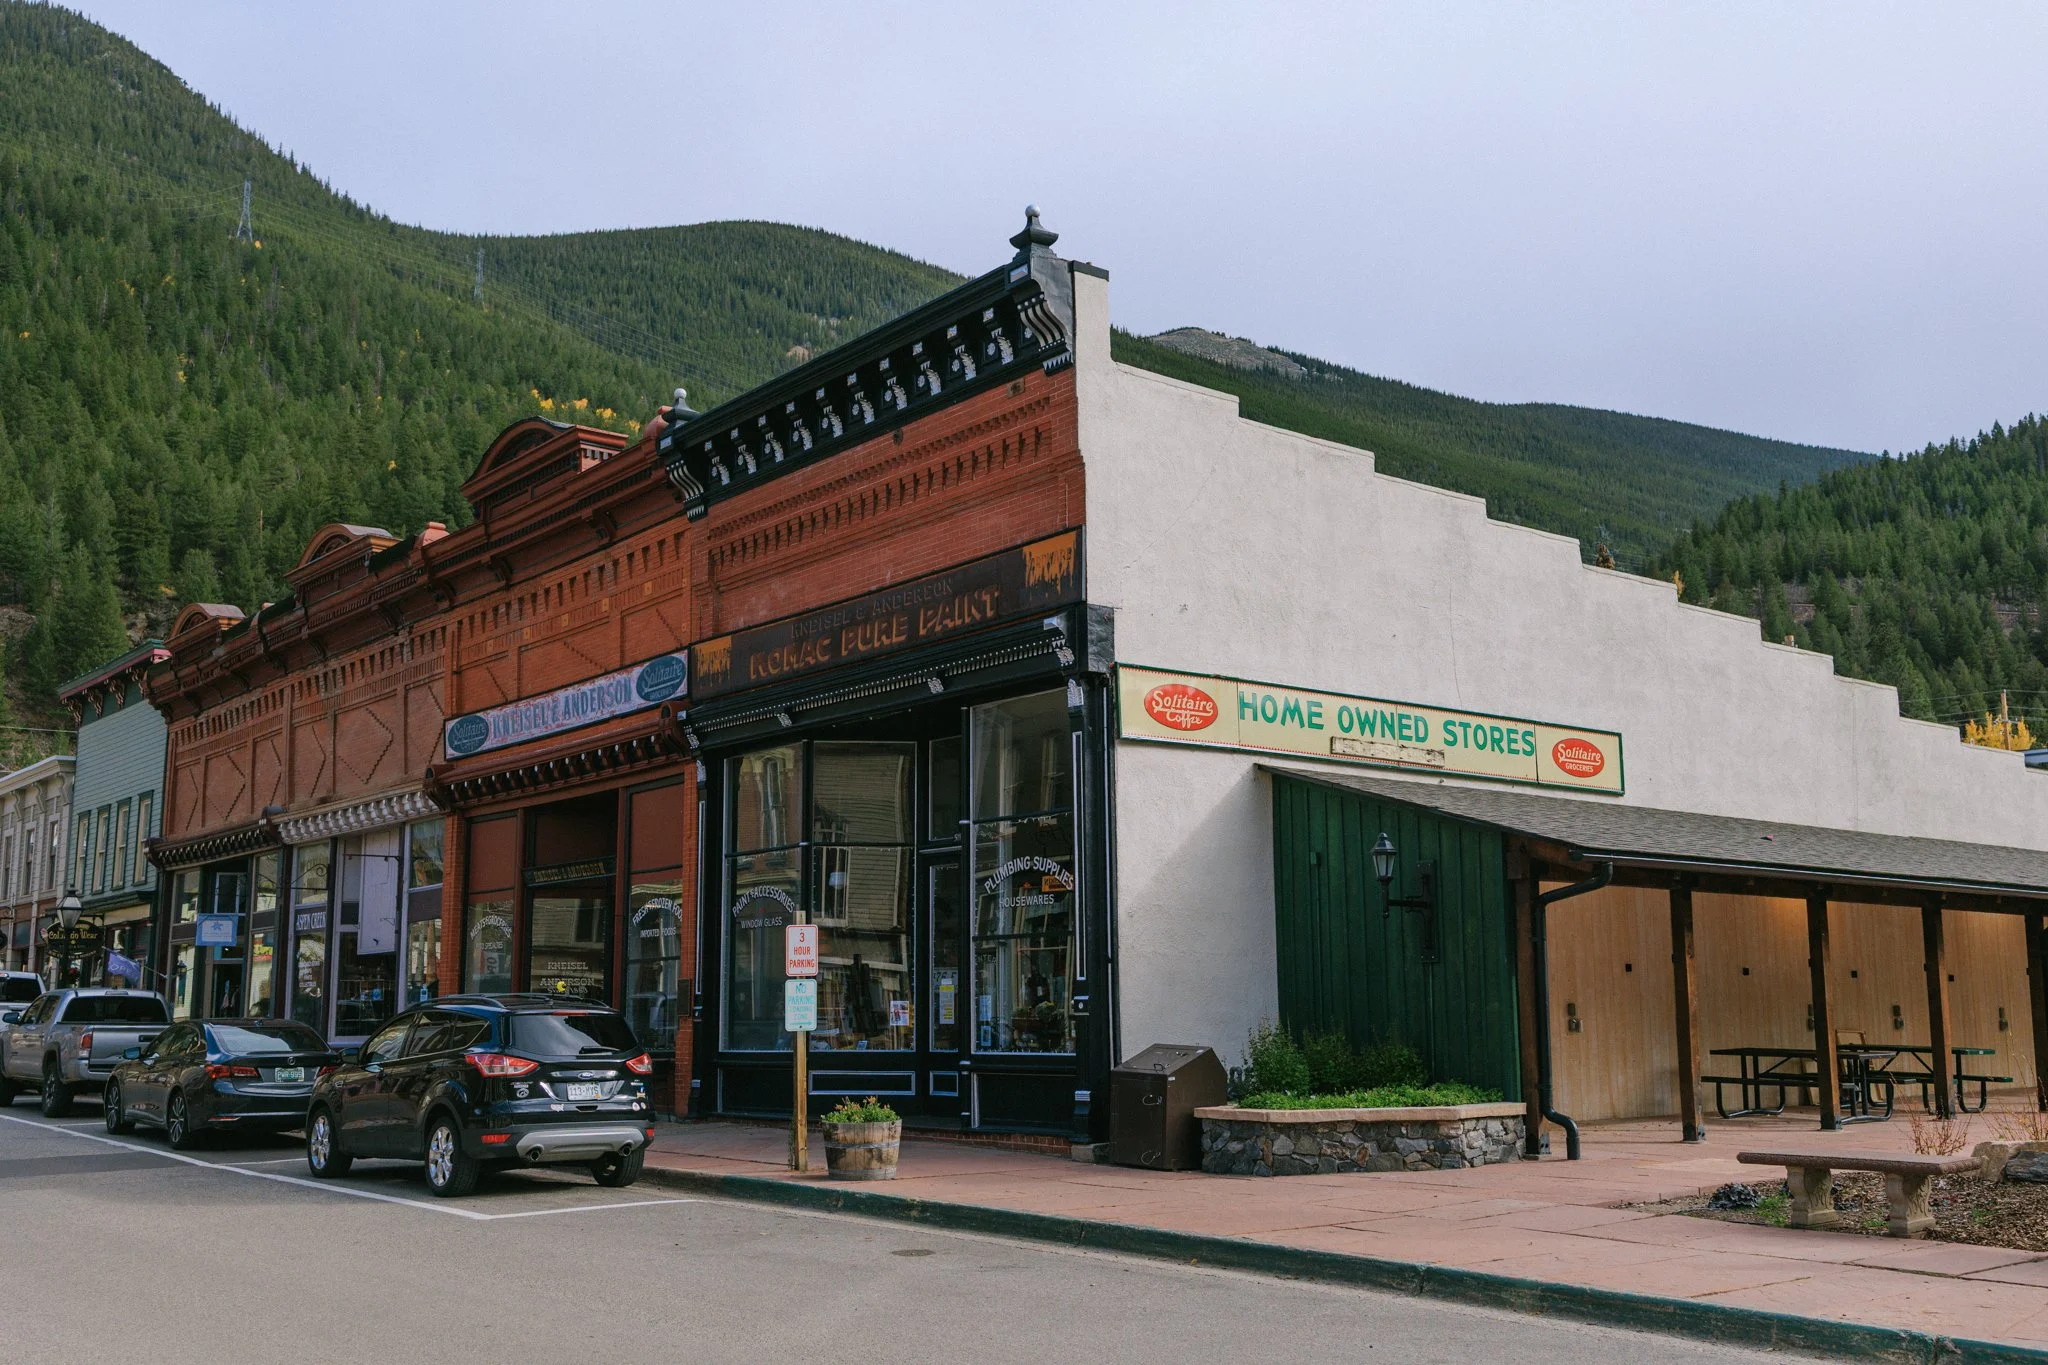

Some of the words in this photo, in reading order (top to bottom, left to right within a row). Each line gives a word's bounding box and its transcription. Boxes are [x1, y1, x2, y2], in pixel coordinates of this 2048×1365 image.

[641, 659, 684, 692] Solitaire
[492, 706, 547, 739] KNEISEL
[563, 677, 632, 721] ANDERSON
[1152, 690, 1214, 719] Solitaire
[1239, 690, 1325, 731] HOME
[1337, 705, 1430, 743] OWNED
[1443, 719, 1536, 757] STORES
[1557, 743, 1602, 764] Solitaire
[1565, 762, 1595, 774] GROCERIES
[984, 855, 1031, 895] PLUMBING
[1032, 855, 1074, 891] SUPPLIES
[732, 891, 750, 918] PAINT
[753, 884, 795, 913] ACCESSORIES
[1000, 893, 1055, 908] HOUSEWARES
[740, 919, 763, 929] WINDOW
[763, 916, 782, 927] GLASS
[799, 932, 805, 943] 3
[793, 946, 811, 956] HOUR
[547, 961, 589, 970] KNEISEL
[789, 959, 815, 969] PARKING
[795, 984, 807, 994] NO
[787, 995, 815, 1005] PARKING
